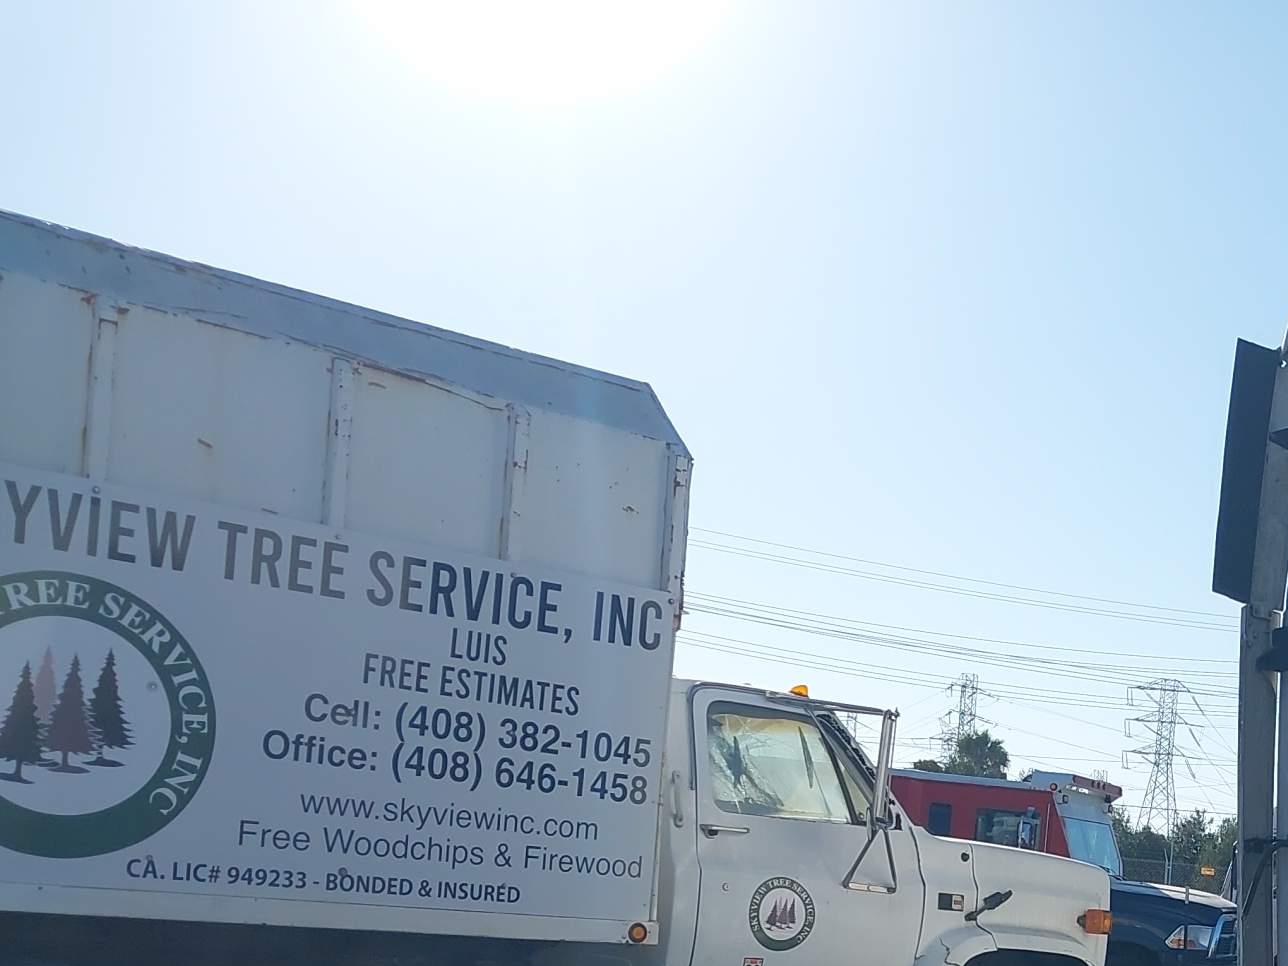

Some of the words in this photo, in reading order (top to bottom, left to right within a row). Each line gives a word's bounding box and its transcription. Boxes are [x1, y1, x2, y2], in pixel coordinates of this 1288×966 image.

[4, 479, 197, 572] YVIEW
[217, 520, 349, 600] TREE
[366, 550, 573, 644] SERVICE,
[593, 591, 663, 651] INC
[99, 591, 208, 745] SERVICE,
[450, 628, 508, 666] LUIS
[363, 653, 431, 693] FREE
[440, 665, 580, 716] ESTIMATES
[304, 693, 382, 731] Cell:
[395, 702, 487, 752] (408)
[498, 717, 652, 768] 382-1045
[150, 751, 203, 815] INC
[262, 729, 378, 771] Office:
[391, 742, 482, 791] (408)
[495, 757, 648, 805] 646-1458
[238, 820, 311, 852] Free
[323, 827, 485, 870] Woodchips
[494, 843, 513, 868] &
[524, 846, 643, 878] Firewood
[300, 794, 599, 841] www.skyviewinc.com
[126, 859, 166, 880] CA.
[172, 862, 220, 884] LIC#
[227, 866, 307, 890] 949233
[325, 873, 413, 897] BONDED
[418, 879, 433, 898] &
[437, 880, 521, 903] INSURED
[767, 878, 792, 889] TREE
